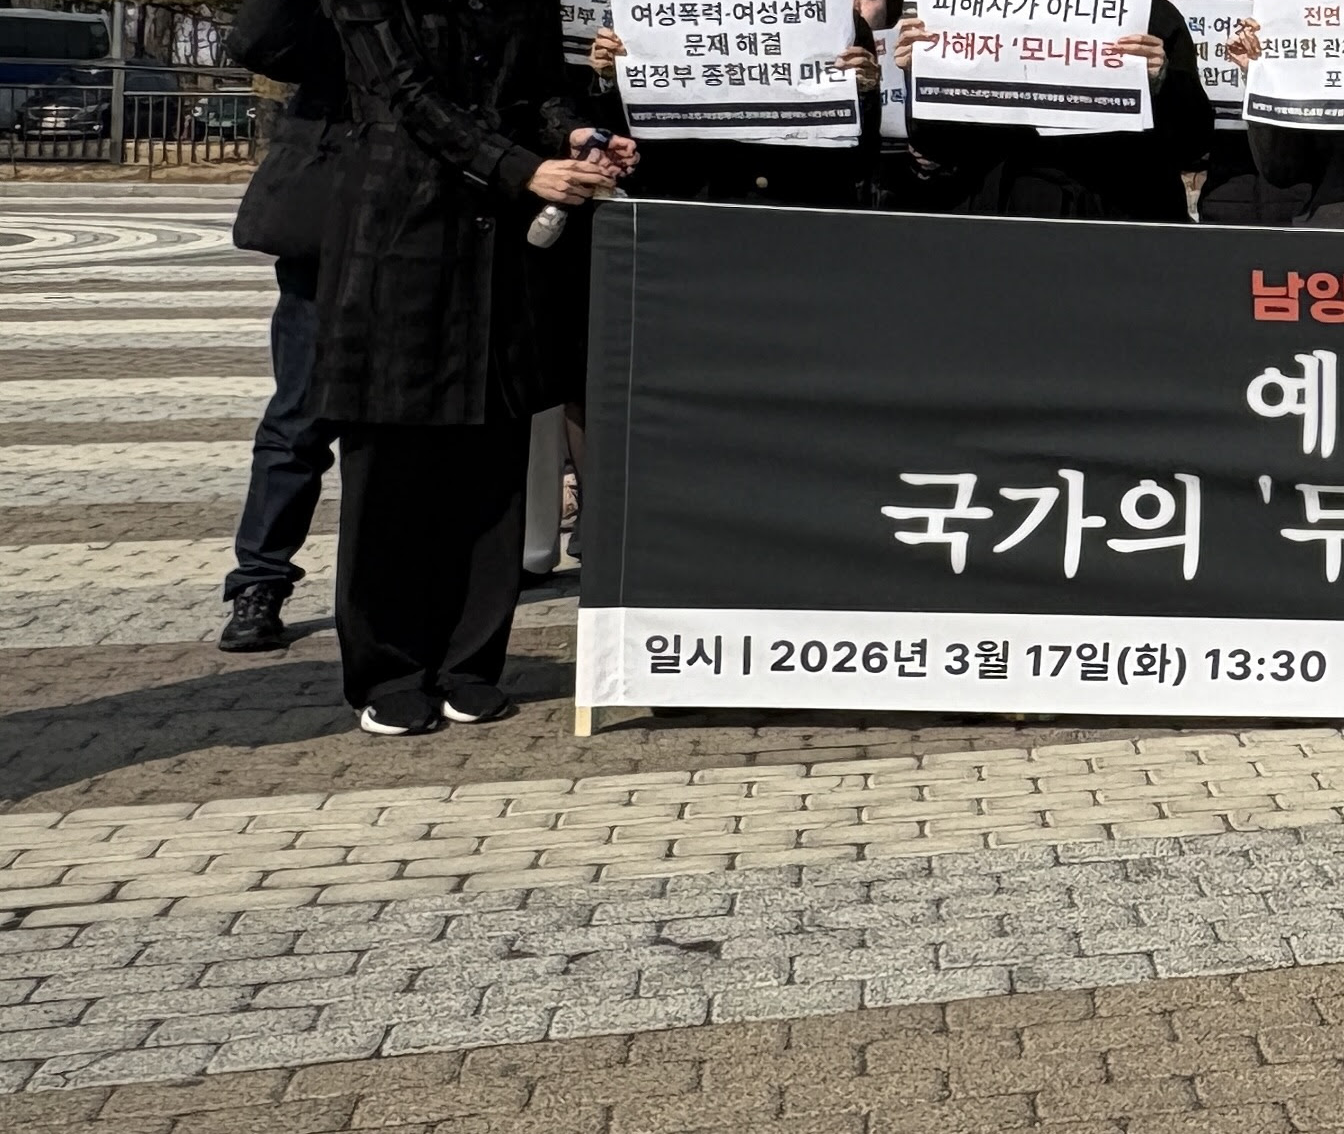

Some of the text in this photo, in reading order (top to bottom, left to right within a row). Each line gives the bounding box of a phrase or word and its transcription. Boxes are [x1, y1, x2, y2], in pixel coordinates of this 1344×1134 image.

[683, 31, 783, 57] 문제 해결
[923, 30, 1004, 63] 가해자
[625, 64, 696, 89] 범정부
[701, 61, 793, 87] 종합대책
[880, 468, 1201, 581] 국가의
[645, 634, 722, 675] 일시
[770, 638, 928, 678] 2026년
[944, 640, 1009, 680] 3월
[1026, 642, 1187, 687] 17일(화)
[1205, 648, 1327, 683] 13:30
